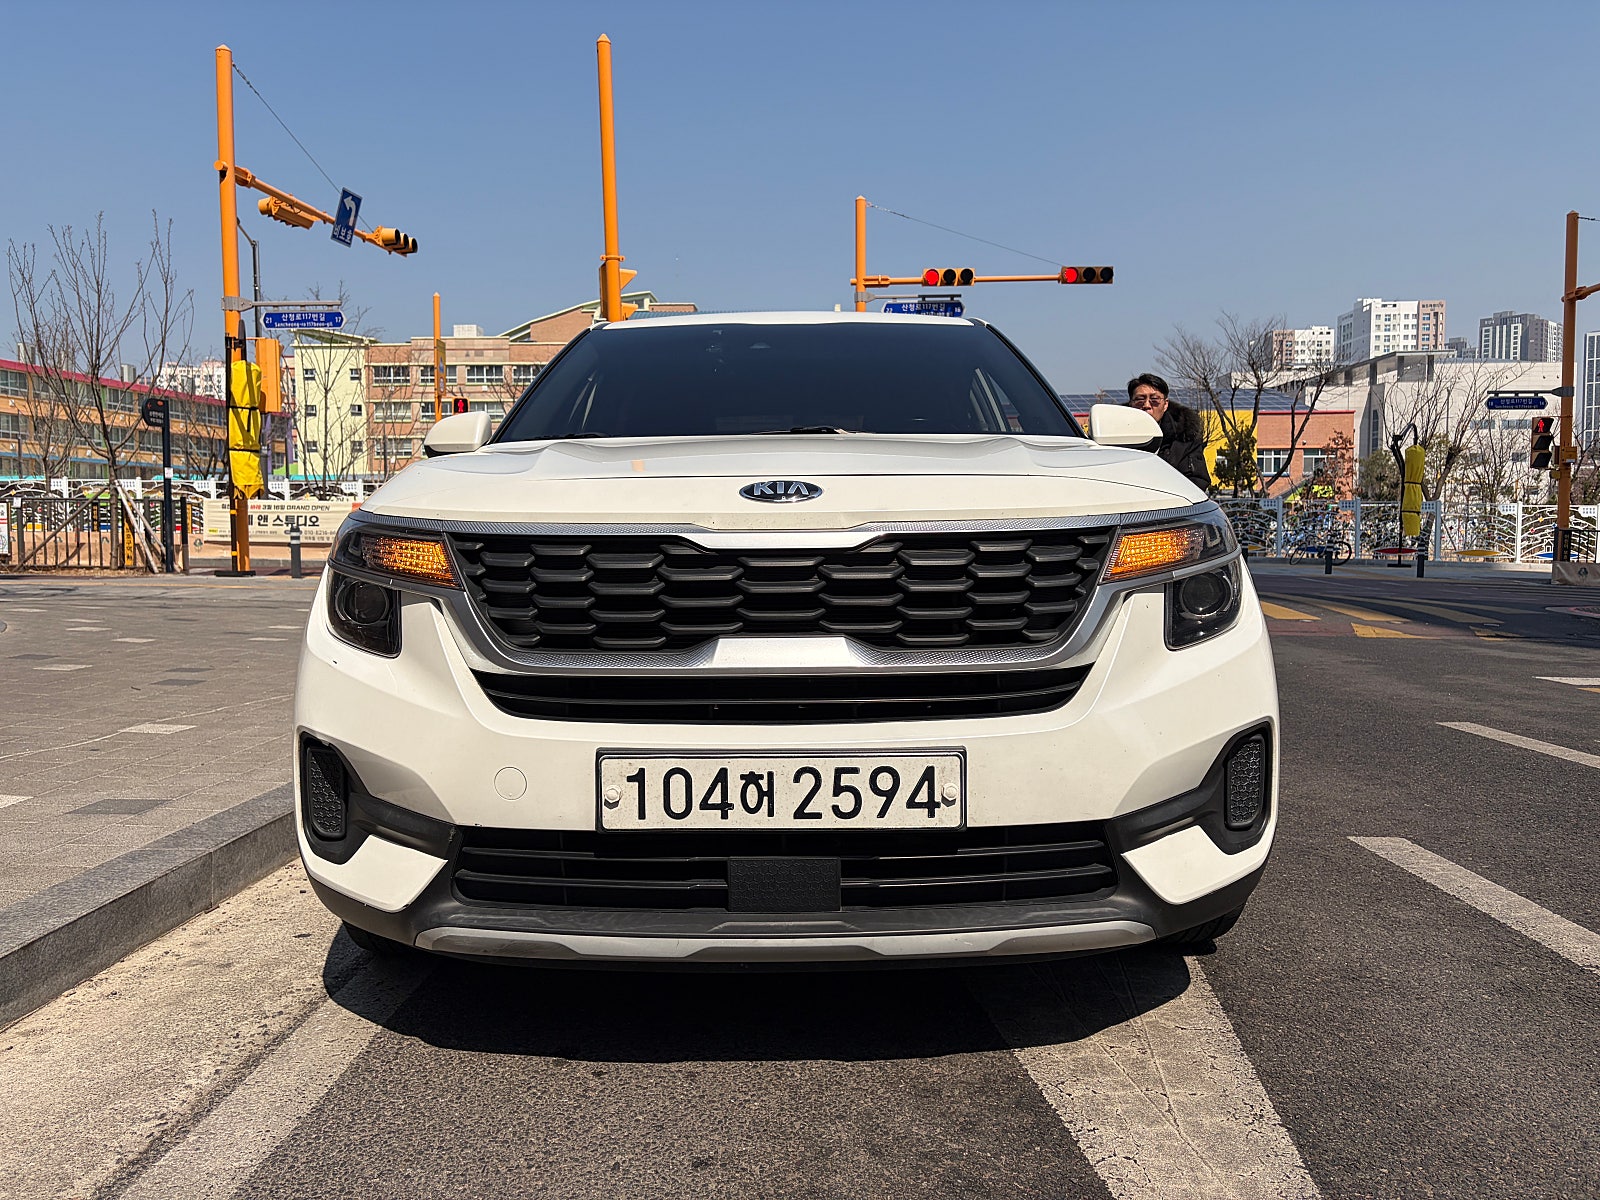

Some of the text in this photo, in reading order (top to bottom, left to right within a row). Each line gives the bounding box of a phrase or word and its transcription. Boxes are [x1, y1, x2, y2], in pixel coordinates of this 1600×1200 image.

[753, 481, 809, 495] KIA
[257, 514, 269, 527] 앤
[272, 514, 320, 527] 스튜디오
[626, 765, 941, 820] 104허 2594
